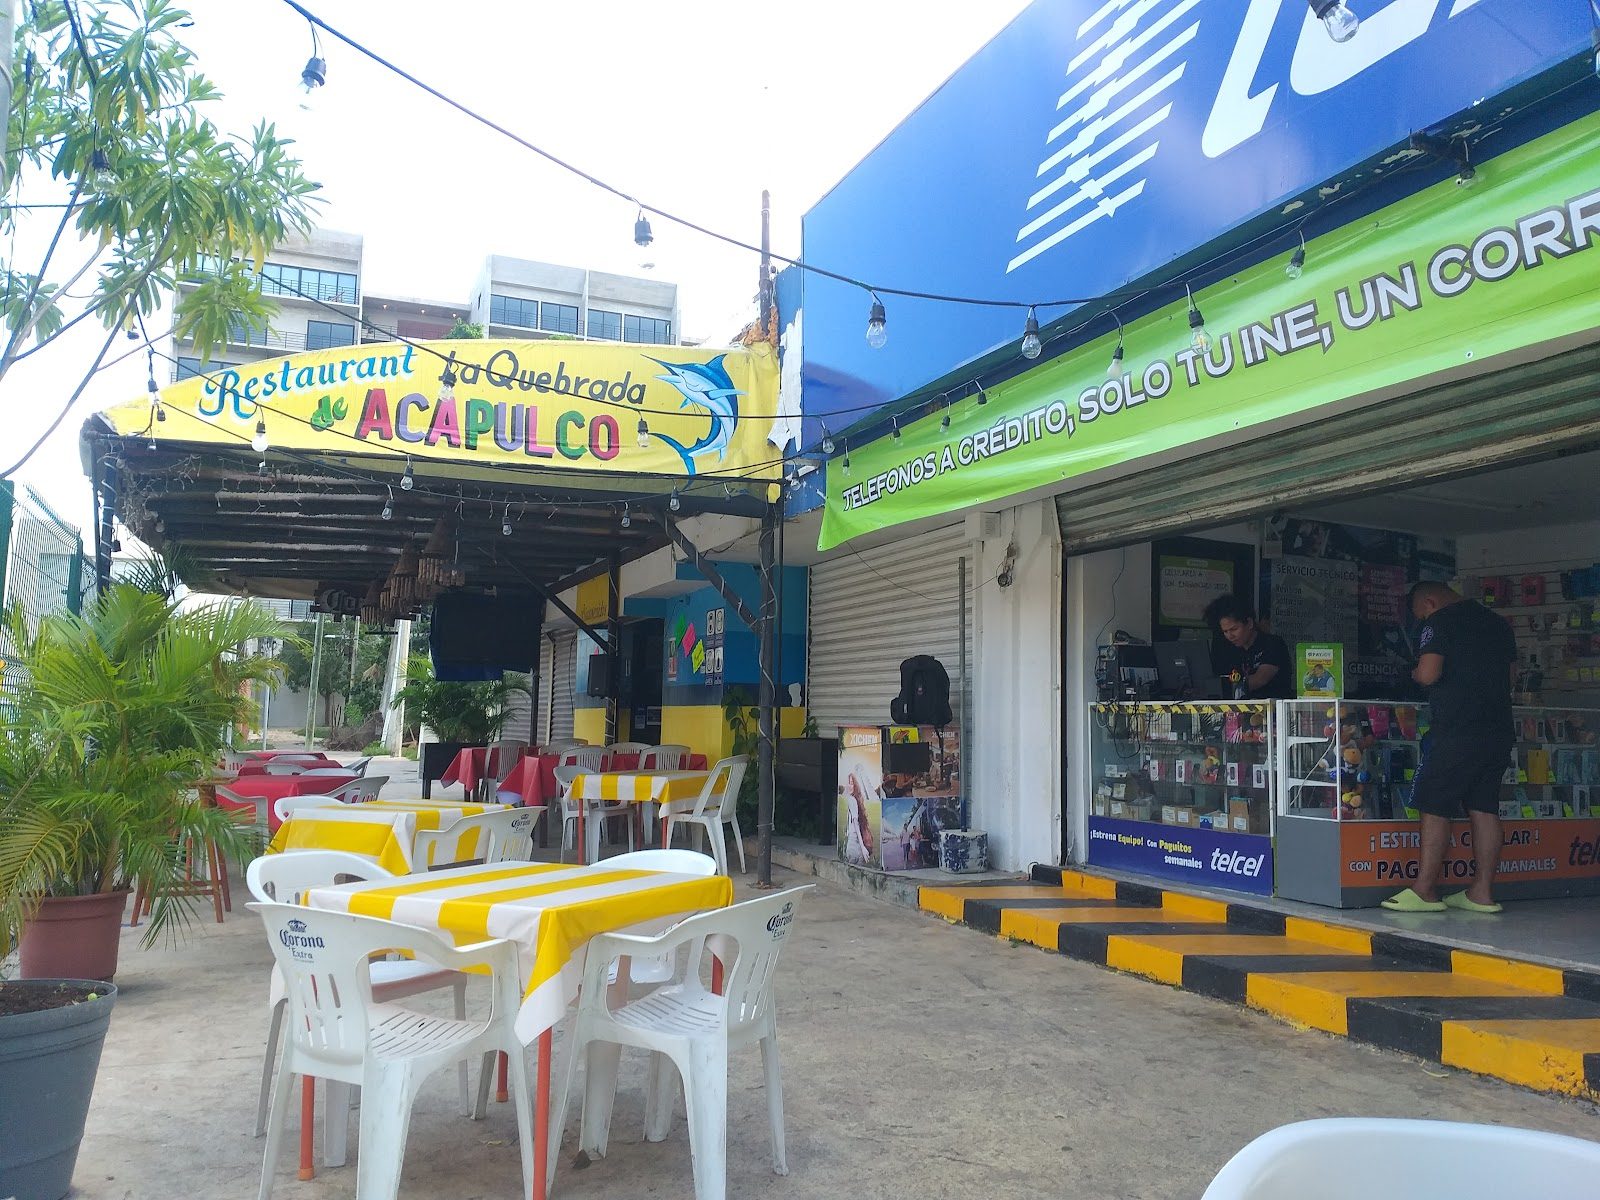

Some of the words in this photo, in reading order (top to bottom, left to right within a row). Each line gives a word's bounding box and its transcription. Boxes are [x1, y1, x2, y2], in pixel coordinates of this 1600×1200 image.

[199, 345, 417, 419] Restaurant
[485, 349, 646, 404] Quebrada
[842, 449, 936, 511] TELEFONOS
[939, 445, 958, 475] A
[957, 416, 1075, 466] CRÉDITO,
[1078, 357, 1173, 424] SOLO
[1175, 331, 1236, 387] TU
[1238, 299, 1335, 355] INE,
[1334, 260, 1423, 331] UN
[310, 395, 348, 431] de
[355, 388, 621, 460] ACAPULCO
[1276, 564, 1317, 577] SERVICIO
[1348, 662, 1399, 676] GERENCIA
[1090, 829, 1117, 841] ¡Estrena
[1118, 834, 1144, 847] Equipo!
[1146, 839, 1157, 848] Con
[1158, 840, 1192, 854] Paguitos
[1380, 832, 1457, 848] ESTRA
[1164, 855, 1202, 870] semanales
[1210, 847, 1265, 877] telcel
[1349, 861, 1372, 872] CON
[1377, 860, 1477, 880] PAGTOS
[767, 913, 794, 931] Corona
[280, 929, 325, 949] Corona
[291, 947, 313, 959] Extra
